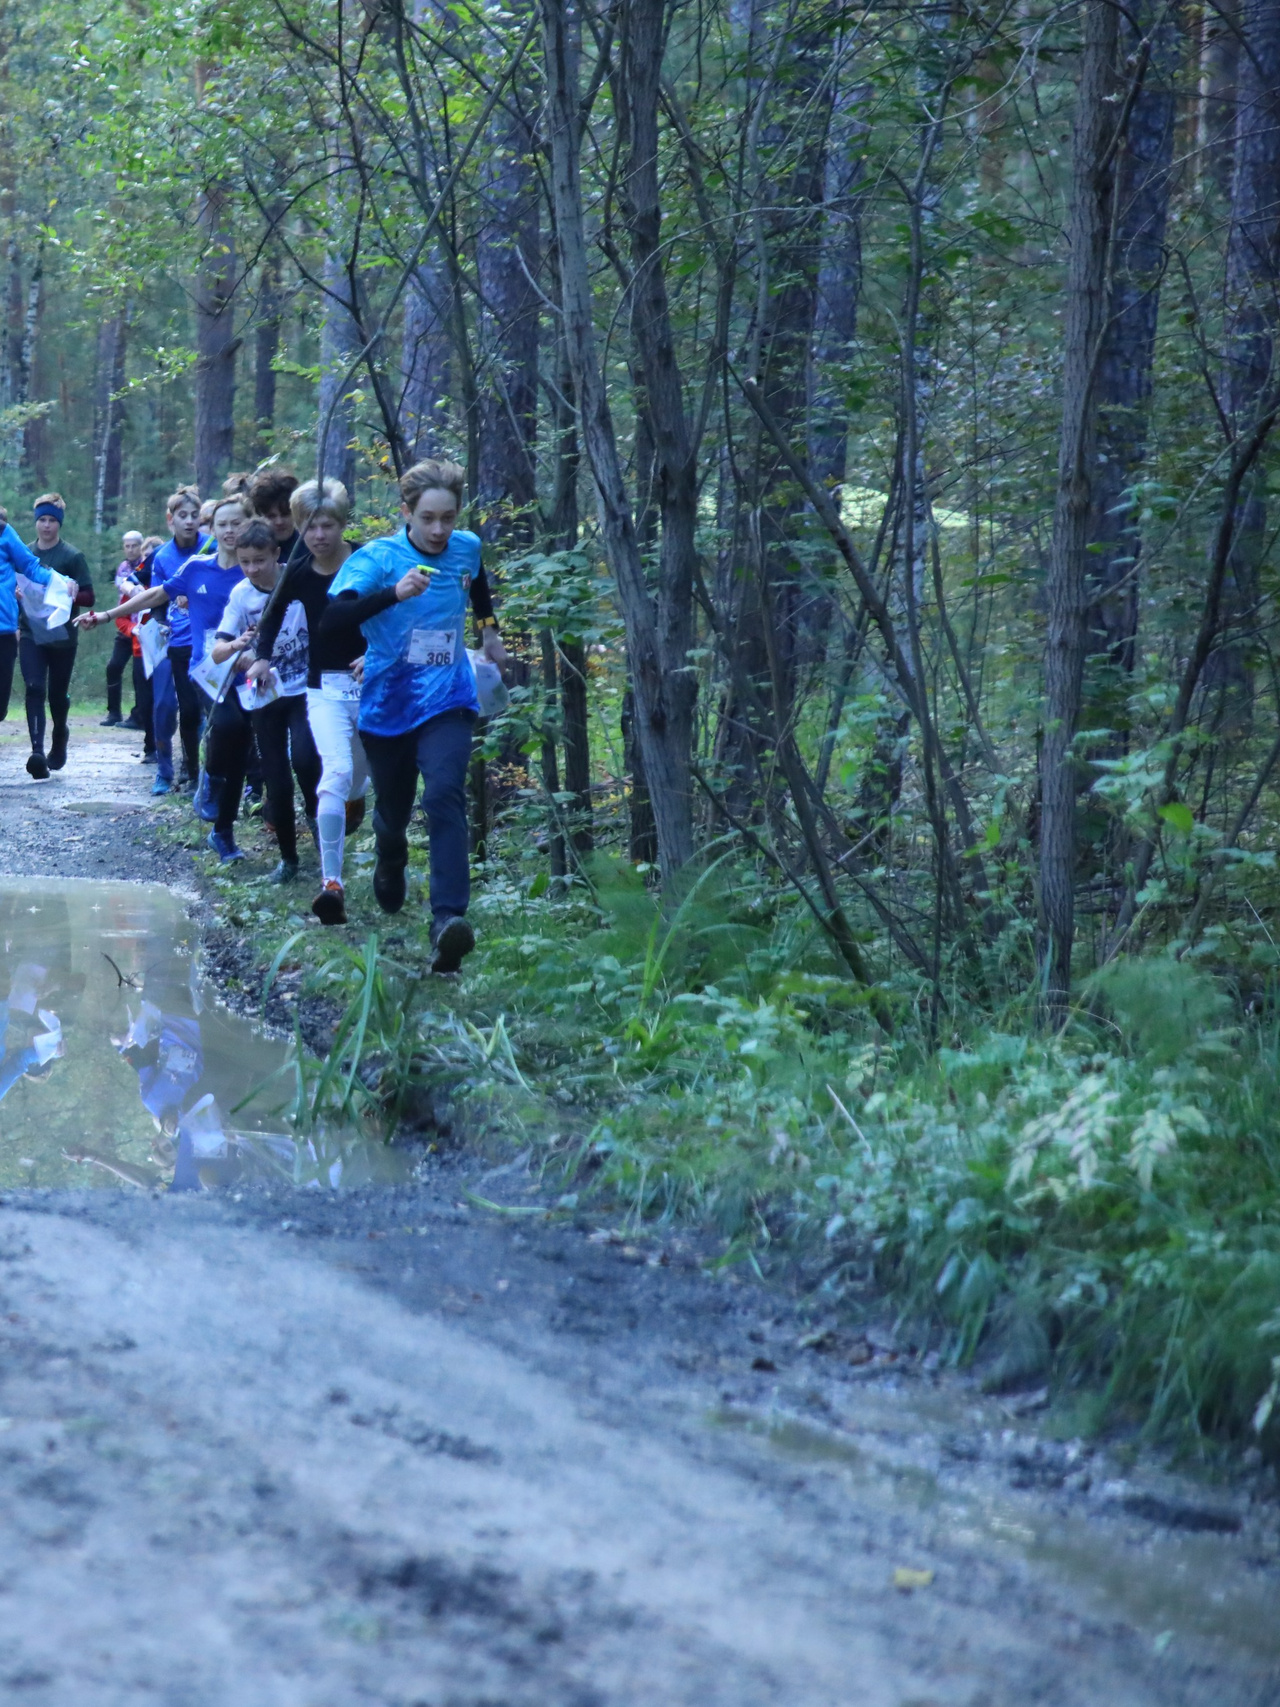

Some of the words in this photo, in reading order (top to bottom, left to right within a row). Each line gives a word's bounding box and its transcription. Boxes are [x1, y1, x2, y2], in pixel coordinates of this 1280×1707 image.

[278, 640, 297, 654] 307
[427, 651, 451, 666] 306
[342, 688, 361, 700] 310
